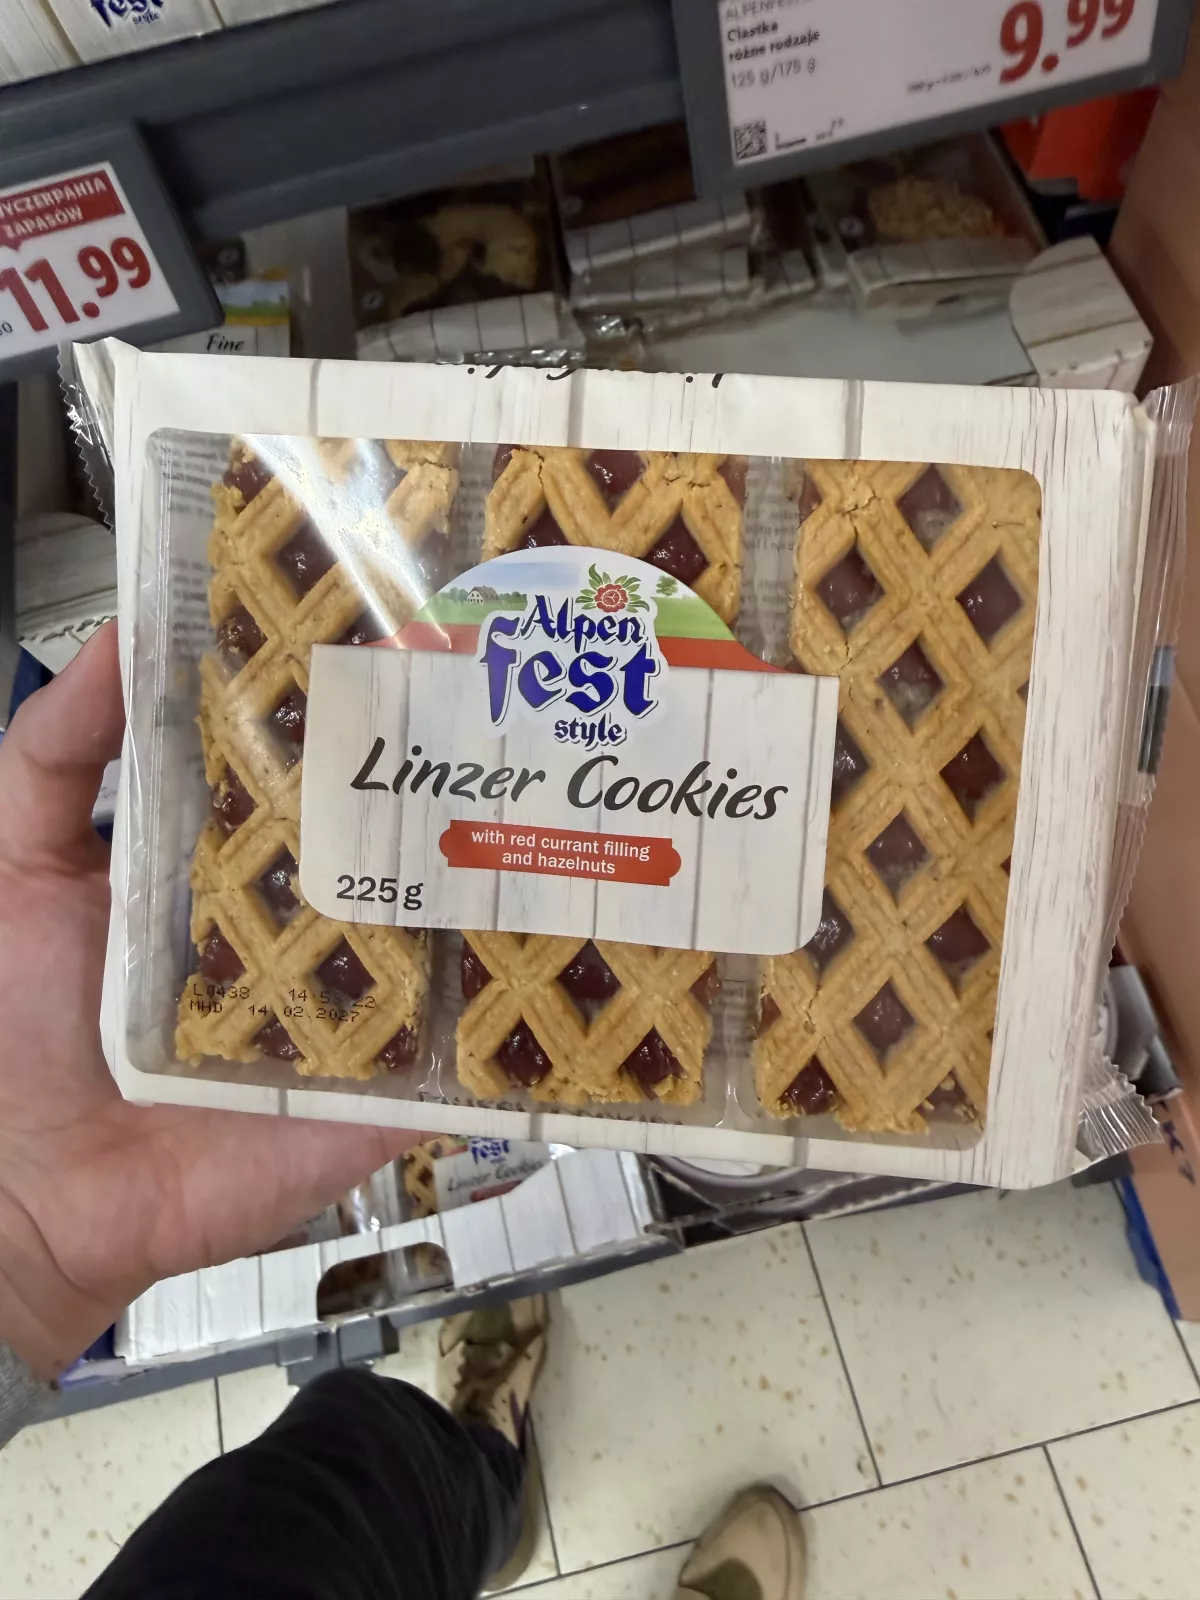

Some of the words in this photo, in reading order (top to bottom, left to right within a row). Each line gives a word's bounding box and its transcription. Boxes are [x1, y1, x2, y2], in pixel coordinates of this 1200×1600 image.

[90, 0, 164, 28] fes
[1000, 0, 1135, 84] 9.99
[0, 236, 152, 332] 11.99
[206, 332, 246, 352] Fine
[520, 594, 648, 654] Alpen
[479, 615, 661, 727] fest
[553, 712, 628, 752] style
[349, 735, 547, 803] Linzer
[566, 754, 789, 821] Cookies
[471, 829, 505, 846] with
[510, 833, 536, 848] red
[541, 837, 599, 855] currant
[604, 841, 651, 862] filling
[502, 850, 533, 866] and
[537, 855, 616, 875] hazelnuts
[189, 999, 224, 1014] MHD
